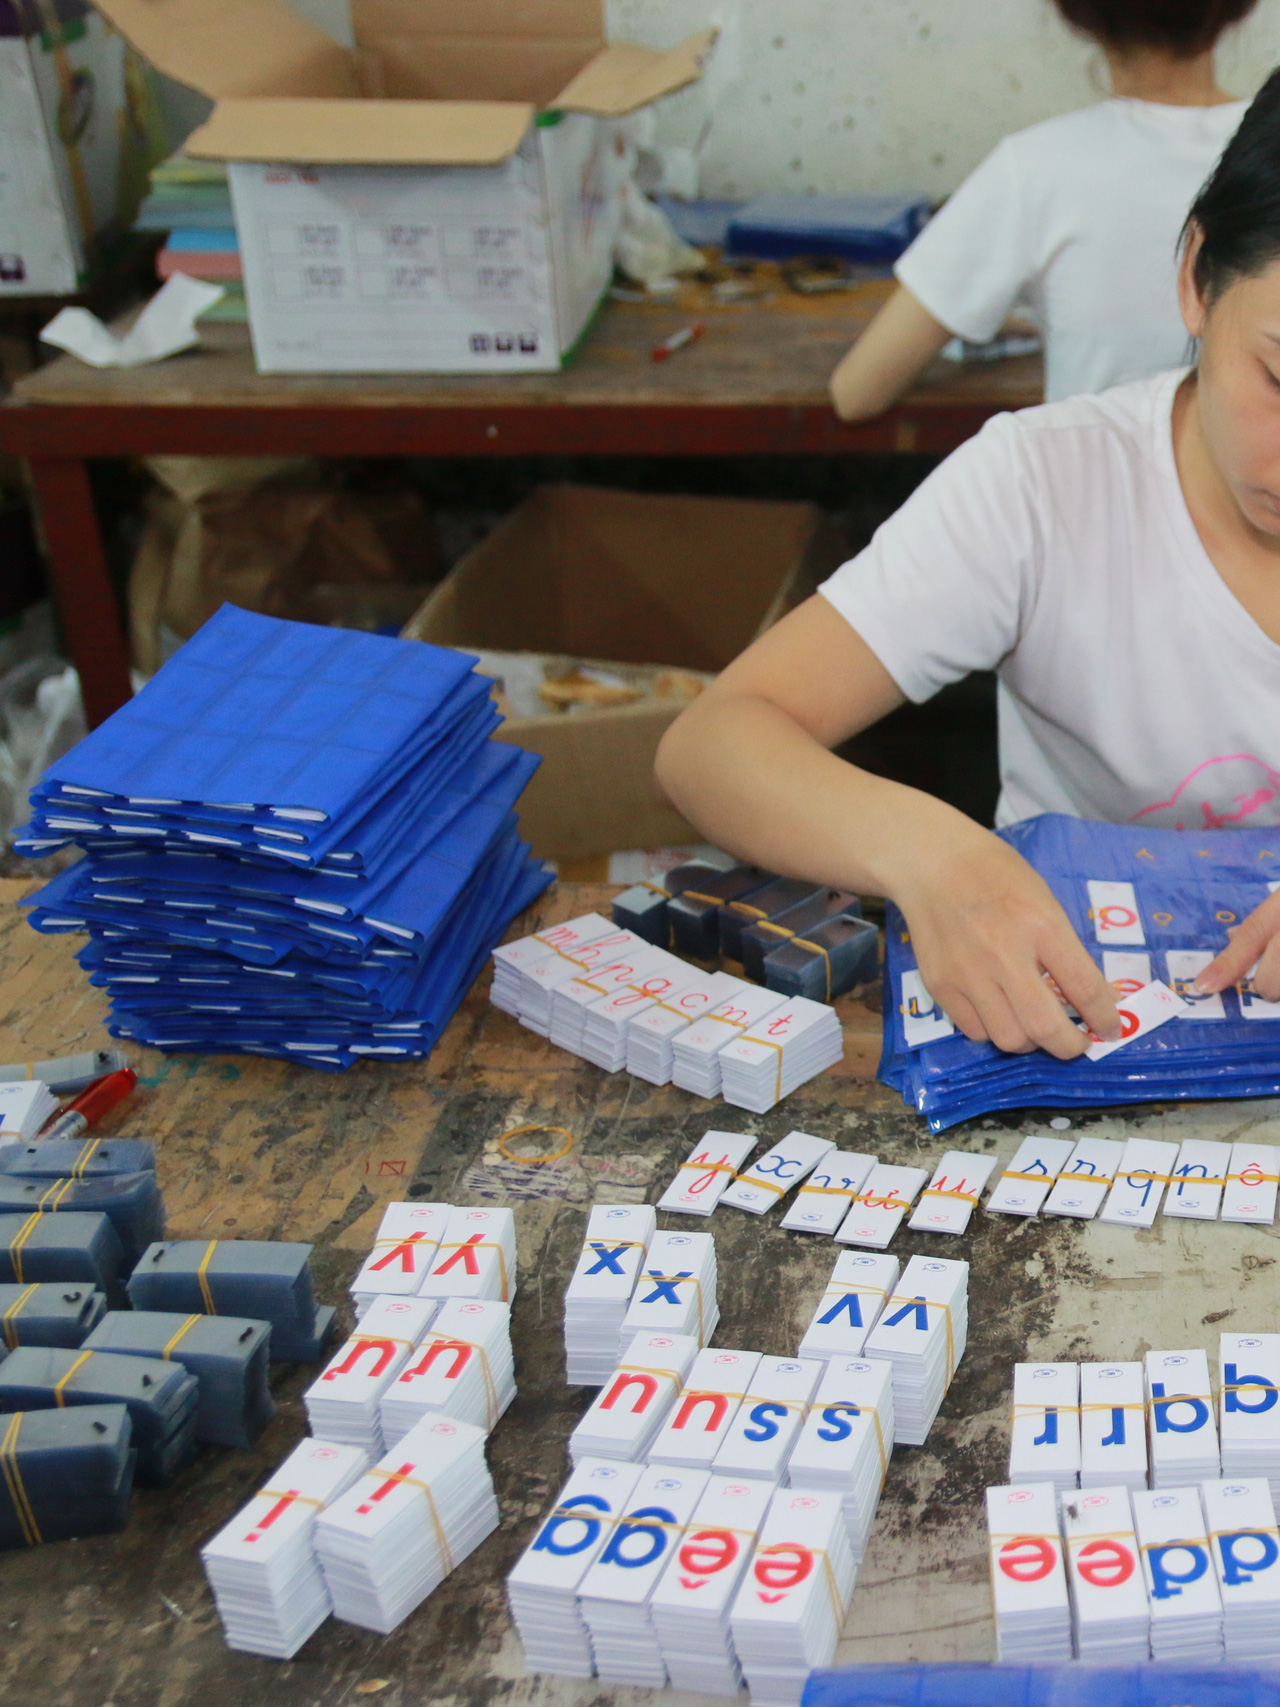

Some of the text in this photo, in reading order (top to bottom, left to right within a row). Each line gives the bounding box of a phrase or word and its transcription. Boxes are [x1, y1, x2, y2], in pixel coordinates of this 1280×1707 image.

[546, 926, 579, 949] m
[571, 936, 631, 966] h
[613, 978, 670, 1006] g
[680, 993, 709, 1008] c
[721, 1005, 748, 1026] n
[768, 1013, 794, 1035] t
[368, 1232, 426, 1272] y
[433, 1234, 485, 1275] y
[584, 1244, 628, 1274] x
[641, 1271, 692, 1304] x
[817, 1295, 863, 1327] v
[883, 1297, 928, 1330] v
[600, 1374, 658, 1413] u
[1152, 1383, 1208, 1433] q
[1225, 1364, 1278, 1414] q
[672, 1392, 728, 1431] u
[744, 1404, 787, 1441] s
[818, 1402, 860, 1441] s
[1034, 1409, 1057, 1445] r
[1102, 1409, 1125, 1446] r
[532, 1495, 612, 1561] g
[599, 1507, 676, 1568] g
[679, 1531, 739, 1589] ê
[754, 1543, 814, 1604] ê
[999, 1537, 1056, 1582] e
[1077, 1540, 1135, 1587] e
[1148, 1538, 1208, 1600] đ
[1219, 1527, 1278, 1585] đ
